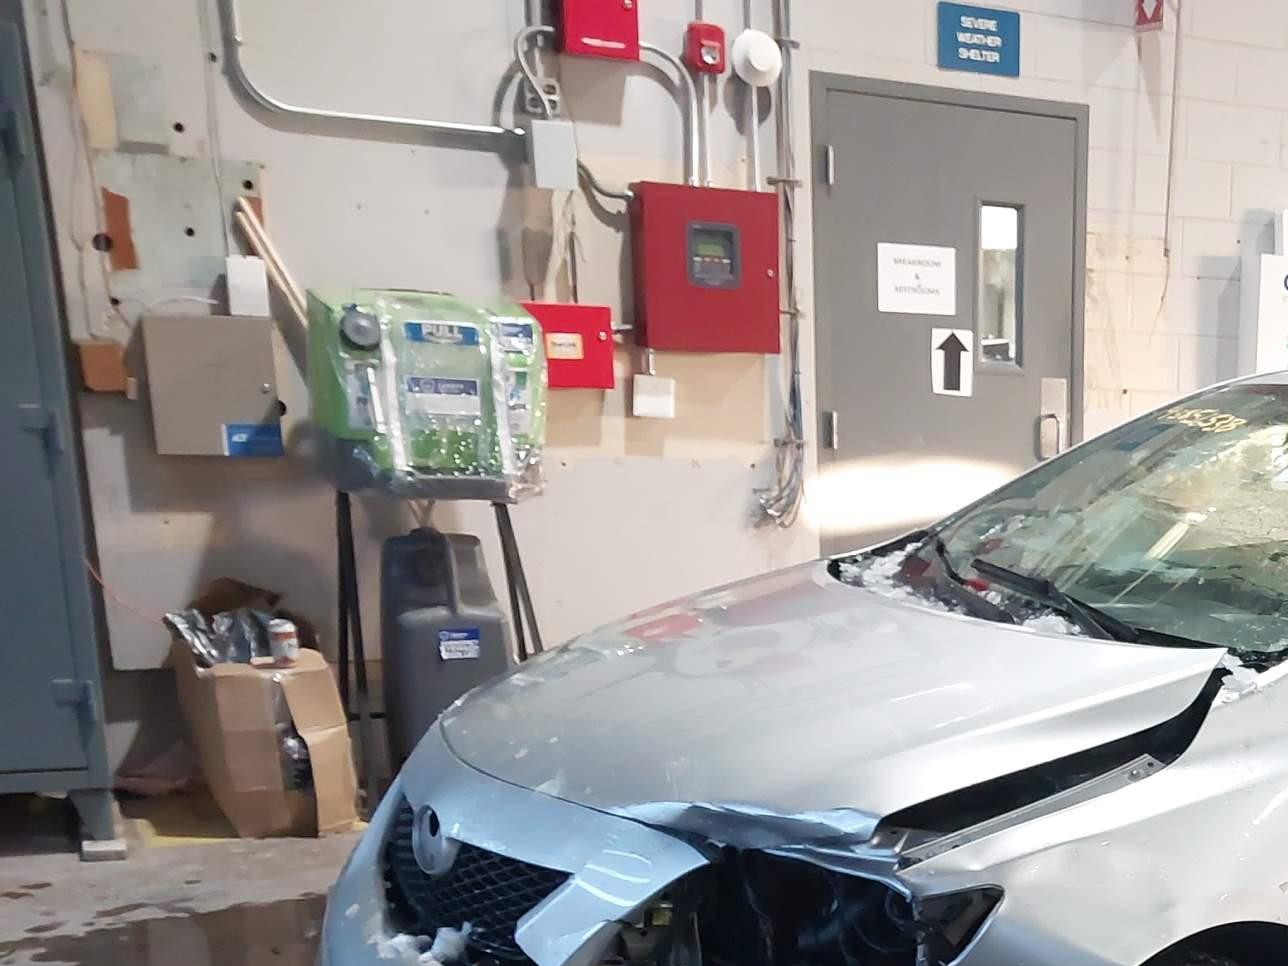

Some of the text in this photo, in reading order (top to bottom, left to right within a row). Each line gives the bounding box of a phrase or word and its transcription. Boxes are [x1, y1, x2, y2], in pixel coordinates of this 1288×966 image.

[960, 15, 998, 32] SEVERE
[955, 31, 1002, 48] WEATHER
[958, 47, 1000, 63] SHELTER
[422, 322, 464, 339] PULL
